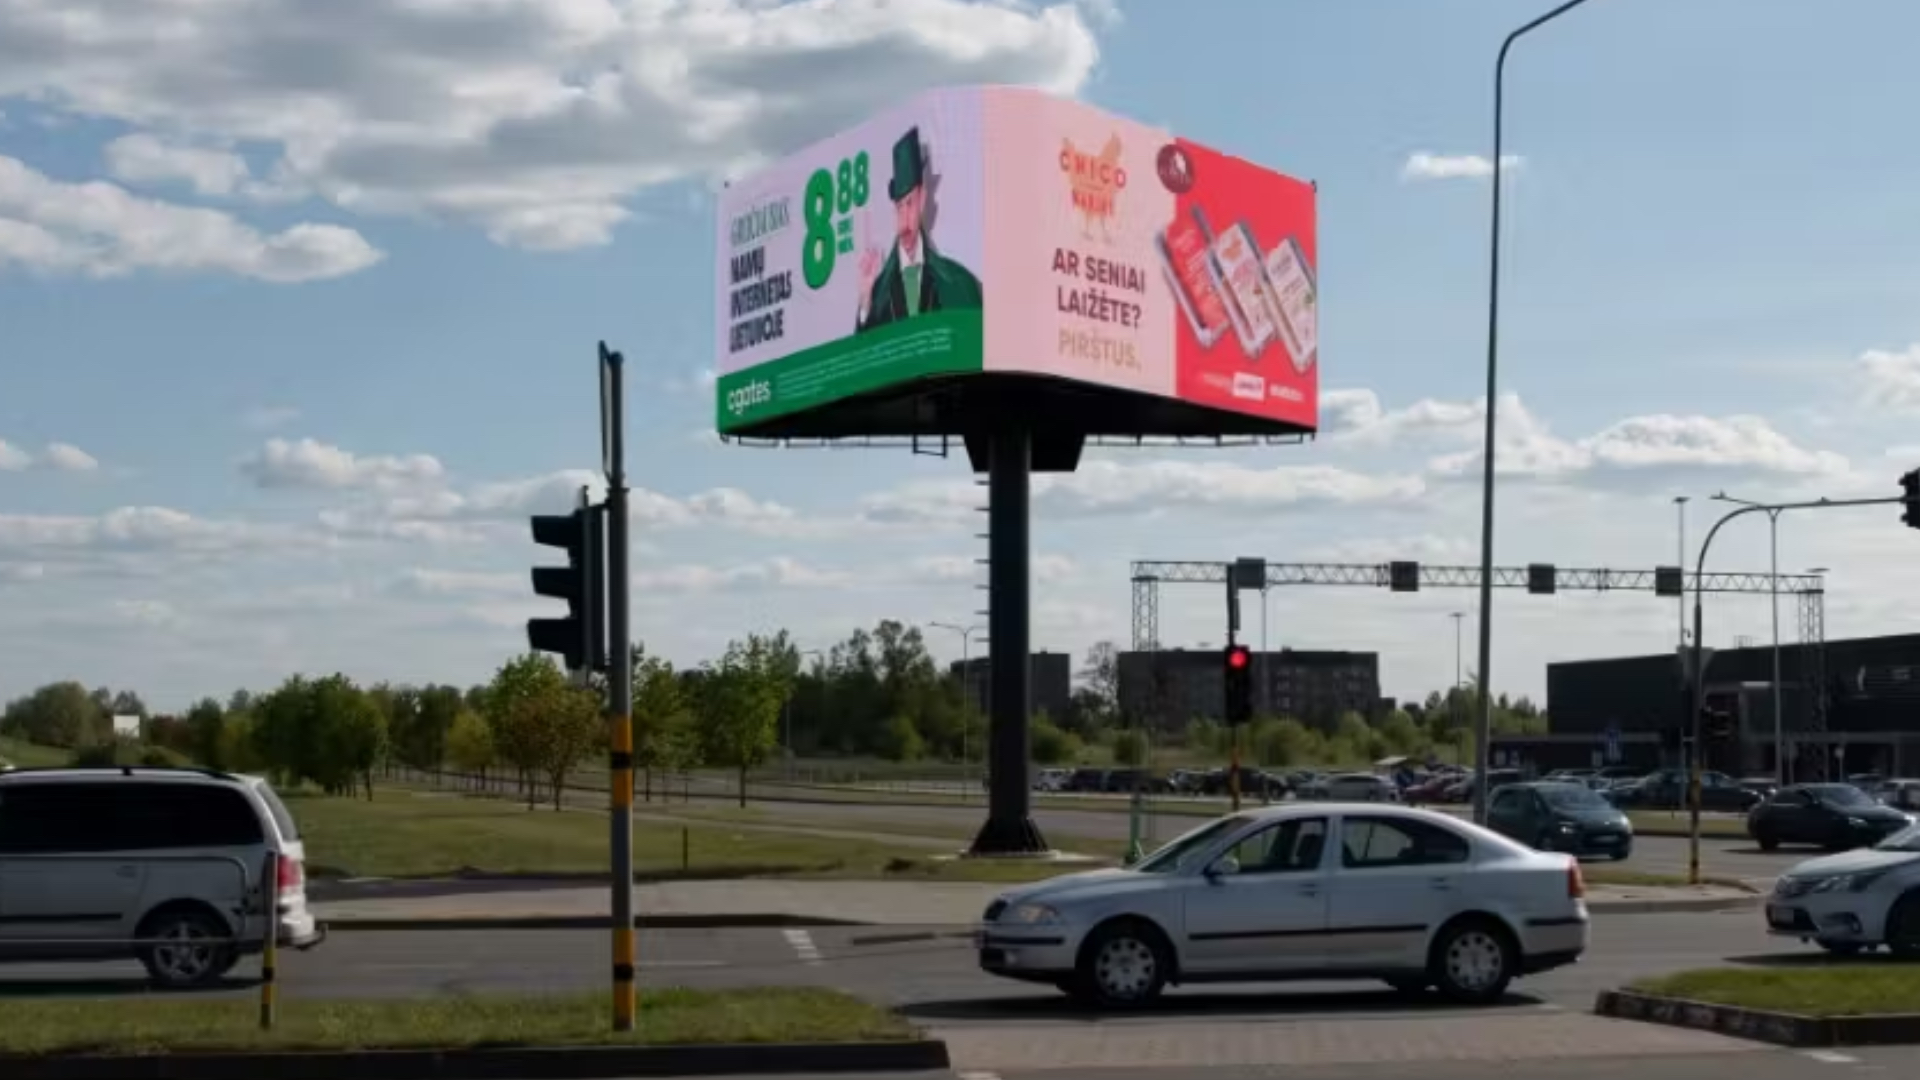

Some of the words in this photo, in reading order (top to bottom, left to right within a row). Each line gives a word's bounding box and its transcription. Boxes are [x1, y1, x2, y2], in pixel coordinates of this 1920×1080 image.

[1059, 150, 1127, 188] CHICO
[803, 168, 836, 290] 8
[731, 270, 792, 318] INTERNETAS
[1052, 248, 1079, 277] AR
[1084, 256, 1145, 295] SENIAI
[730, 308, 784, 353] LIETUVOJE
[1057, 287, 1141, 329] LAIŽĖTE?
[1058, 328, 1142, 371] PIRŠTUS.
